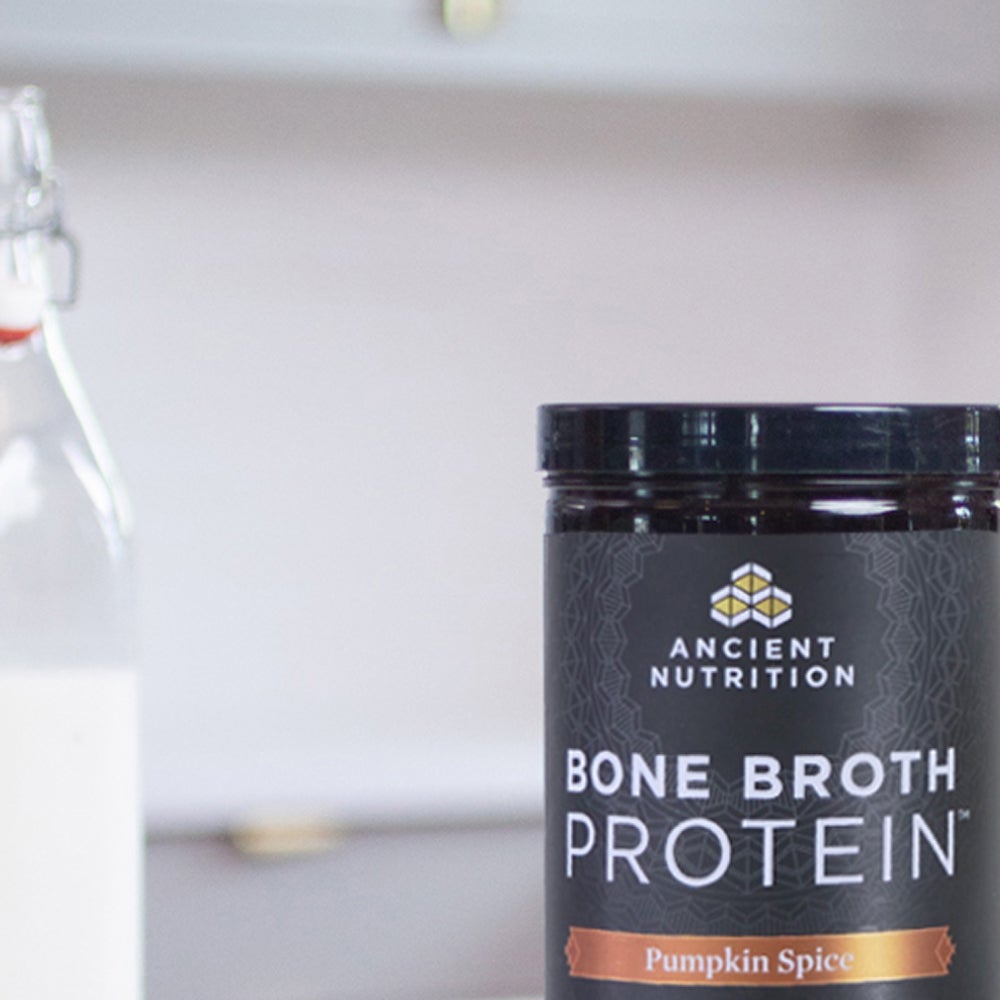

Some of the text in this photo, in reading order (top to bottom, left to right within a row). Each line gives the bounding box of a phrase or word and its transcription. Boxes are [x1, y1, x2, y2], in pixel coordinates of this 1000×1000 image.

[670, 637, 836, 659] ANCIENT
[650, 665, 856, 688] NUTRITION
[566, 747, 956, 800] BONE BROTH
[566, 809, 956, 887] PROTEIN
[645, 946, 856, 980] Pumpkin Spice
